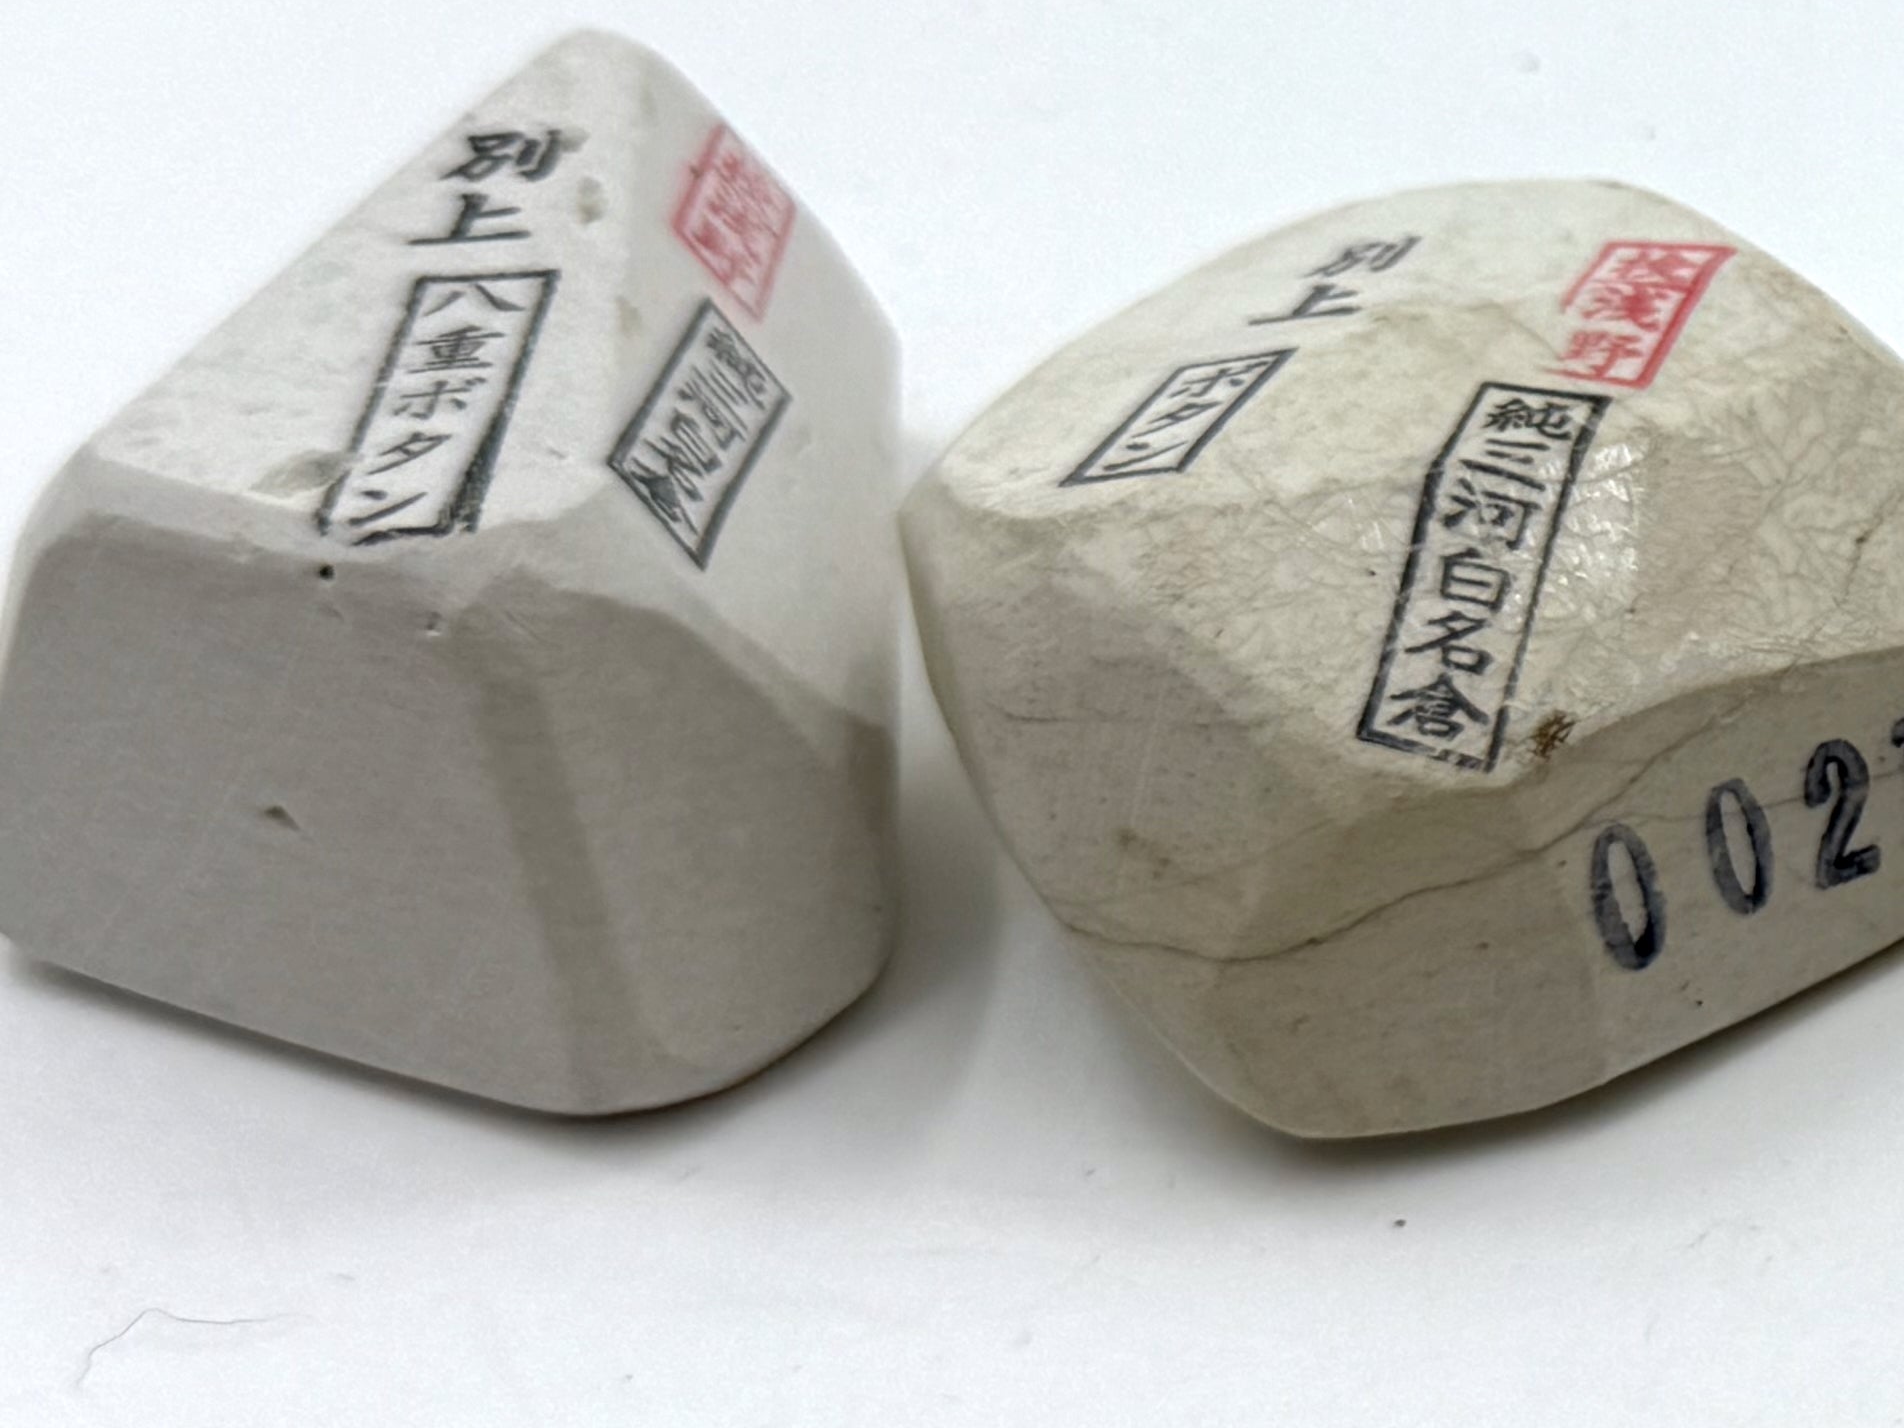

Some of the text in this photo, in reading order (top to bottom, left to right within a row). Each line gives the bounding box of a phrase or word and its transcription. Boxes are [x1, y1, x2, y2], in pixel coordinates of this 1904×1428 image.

[347, 281, 528, 528] 八重ボタン
[1388, 394, 1574, 742] 純三河白名倉
